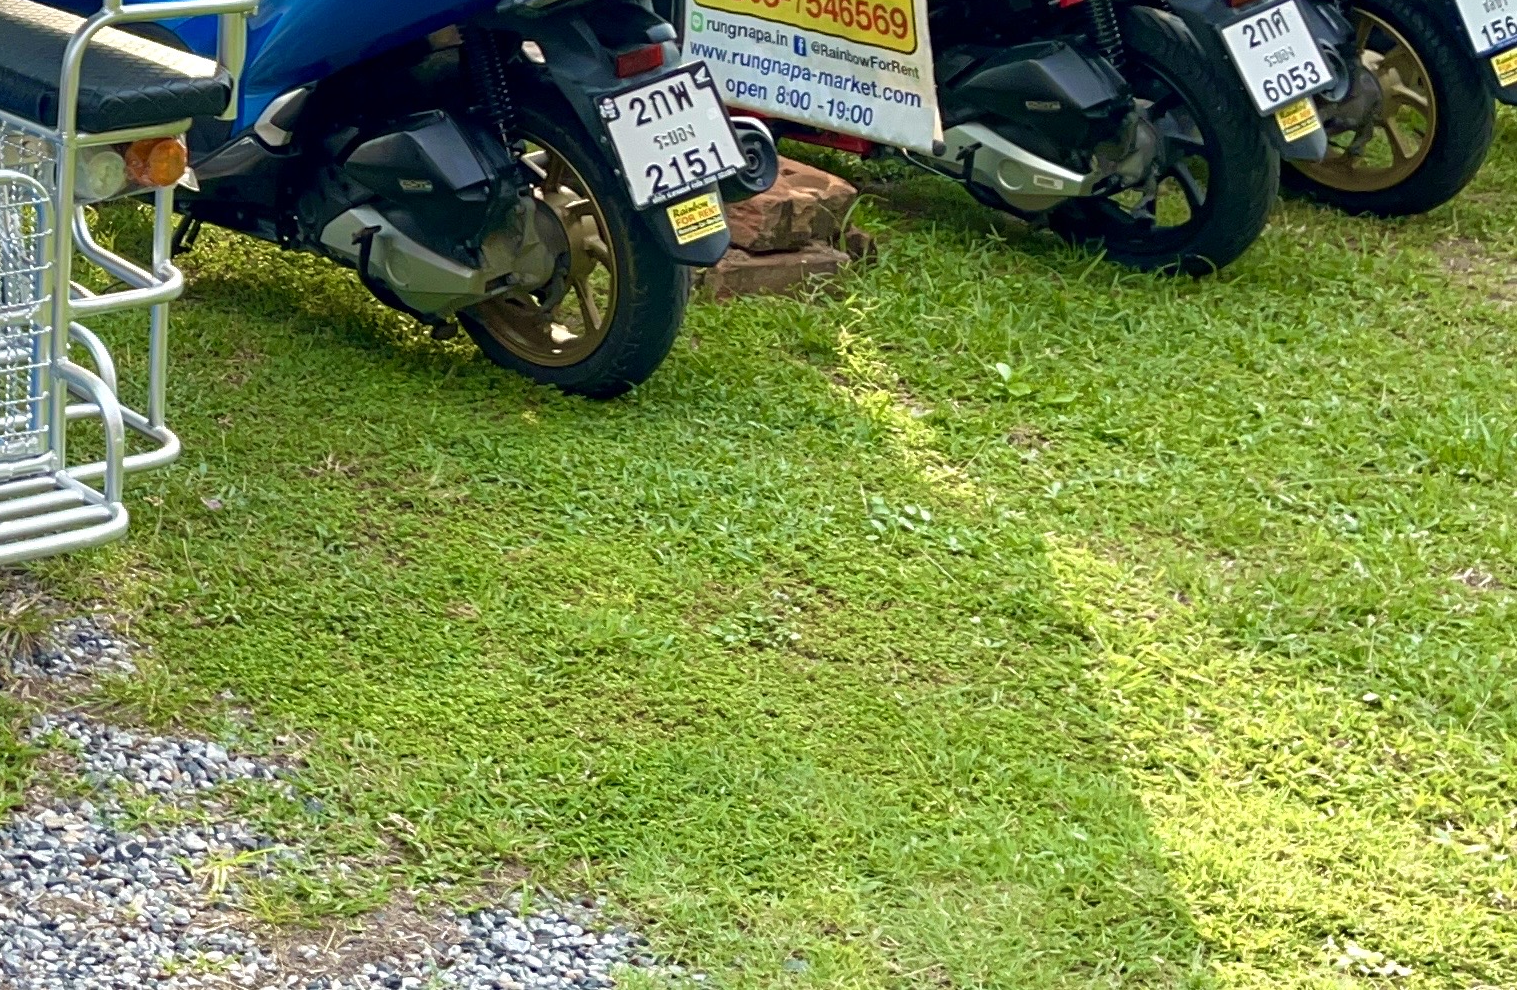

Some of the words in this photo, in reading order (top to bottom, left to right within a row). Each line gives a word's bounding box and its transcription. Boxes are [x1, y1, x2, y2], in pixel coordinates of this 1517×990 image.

[706, 16, 788, 48] rungnapa.in
[810, 40, 920, 80] @RainbowForRent
[690, 40, 922, 109] www.rungnapa-market.com
[725, 77, 768, 103] open
[775, 85, 811, 111] 8:00
[1263, 61, 1321, 103] 6053
[653, 123, 697, 150] ระยอง
[645, 141, 725, 195] 2151
